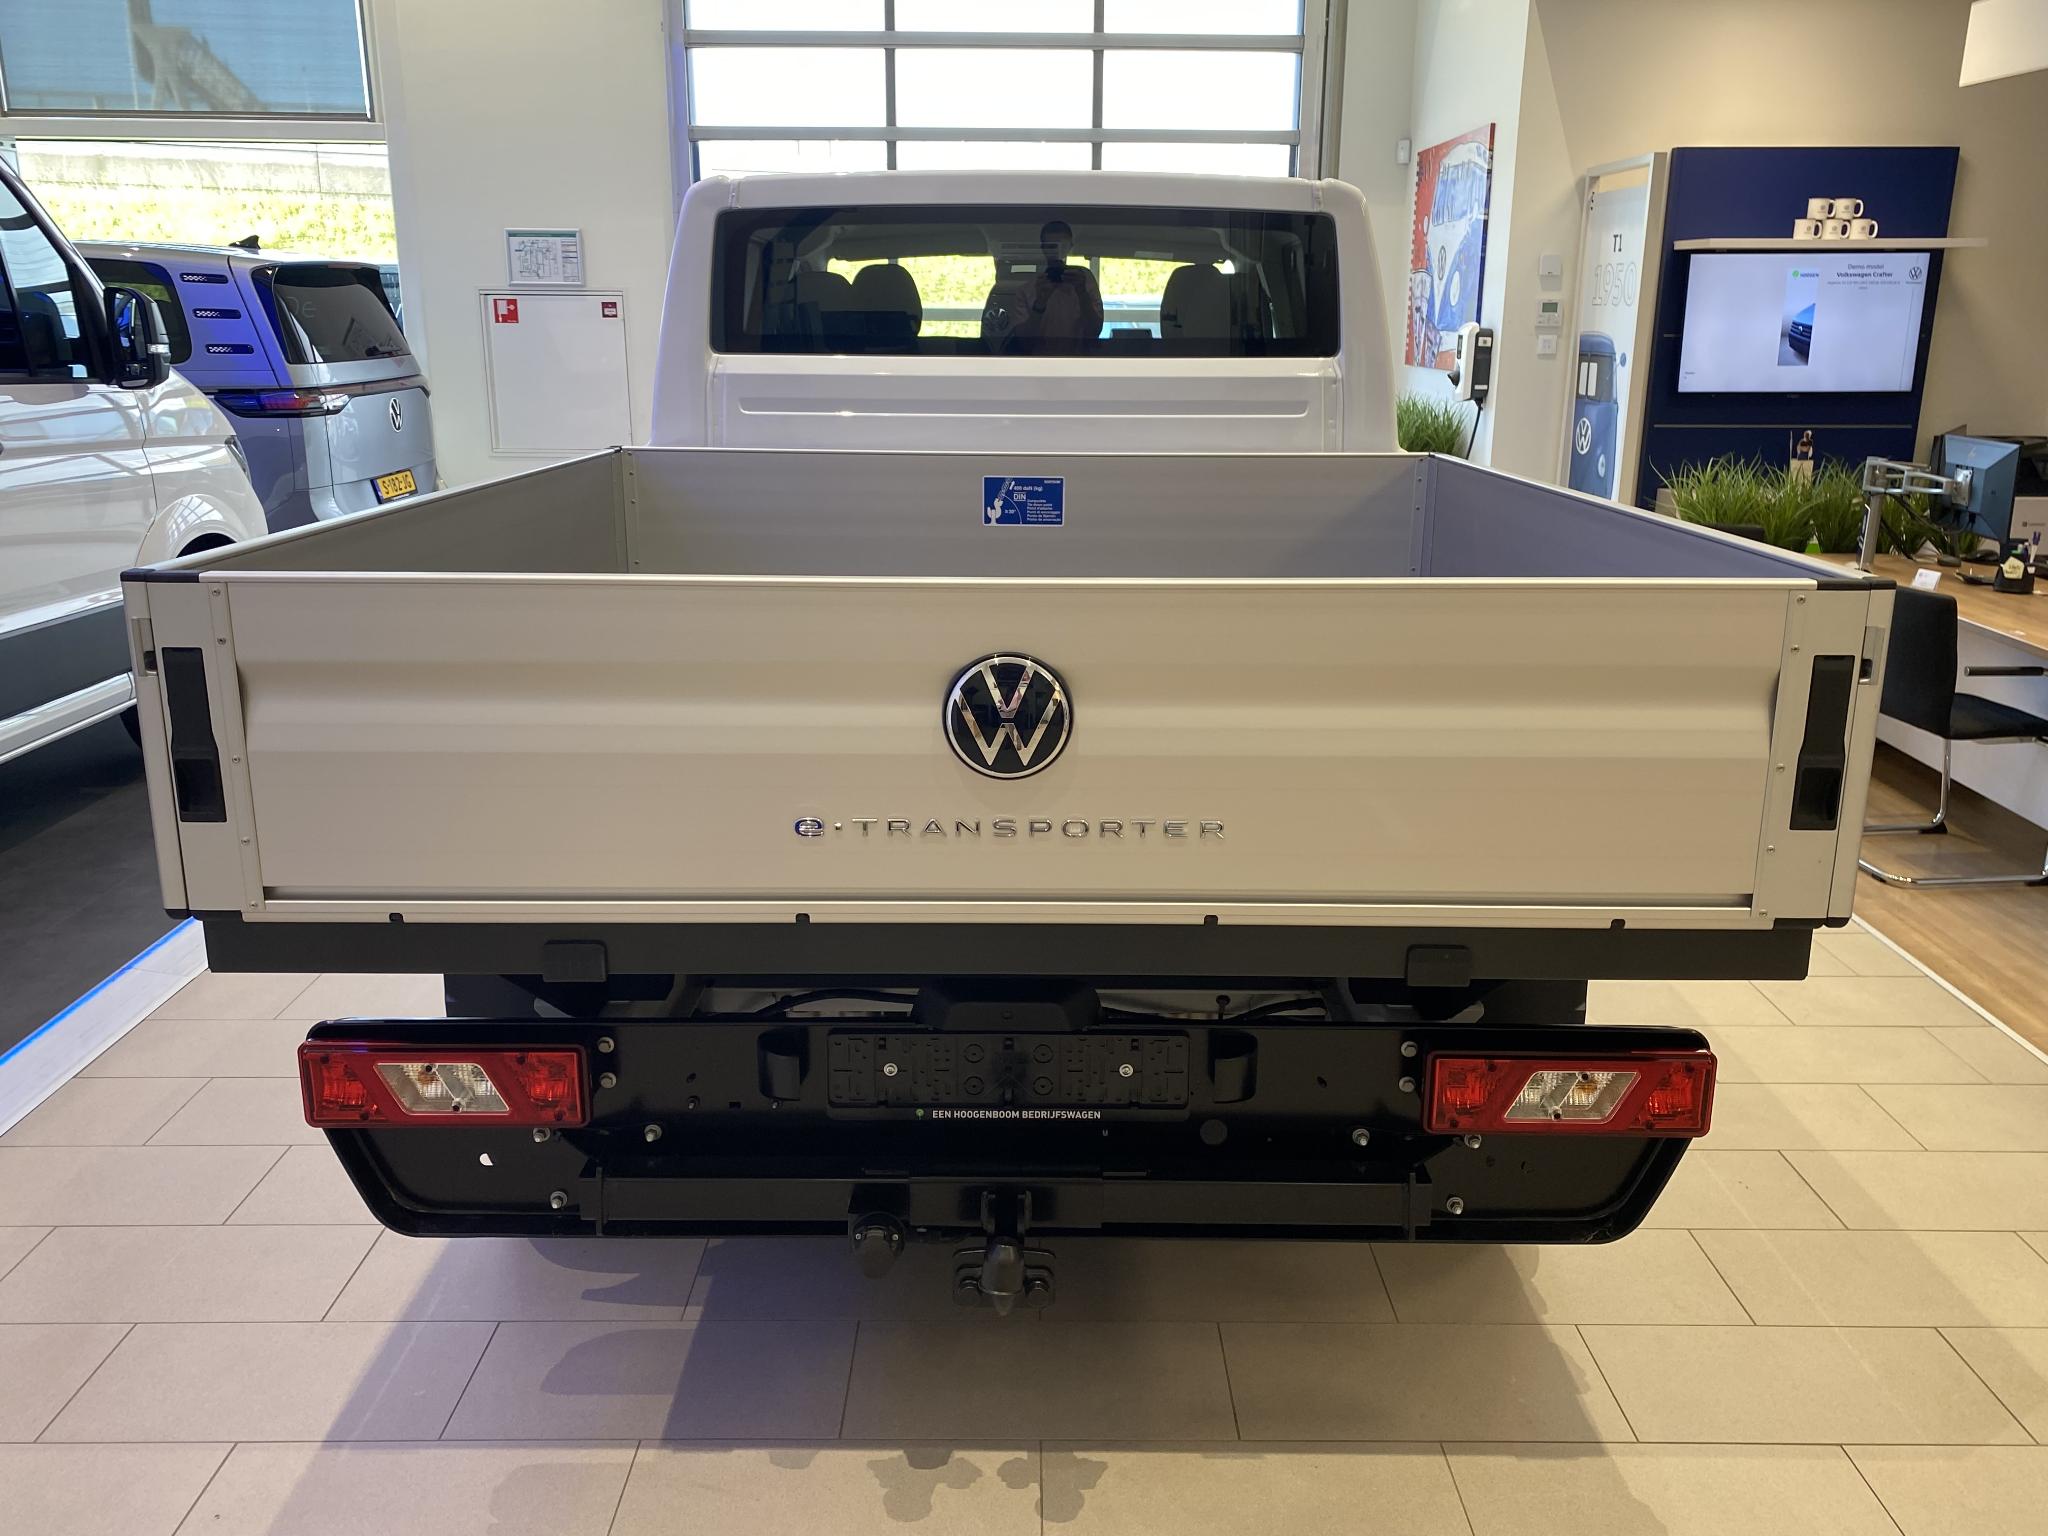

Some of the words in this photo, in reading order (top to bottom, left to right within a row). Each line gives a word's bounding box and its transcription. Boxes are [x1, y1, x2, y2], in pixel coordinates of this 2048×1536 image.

[1592, 262, 1637, 307] 1950
[932, 1110, 951, 1119] EEN
[953, 1110, 1020, 1119] HOOGENBOOM
[1022, 1110, 1101, 1119] BEDRIJFSWAGEN
